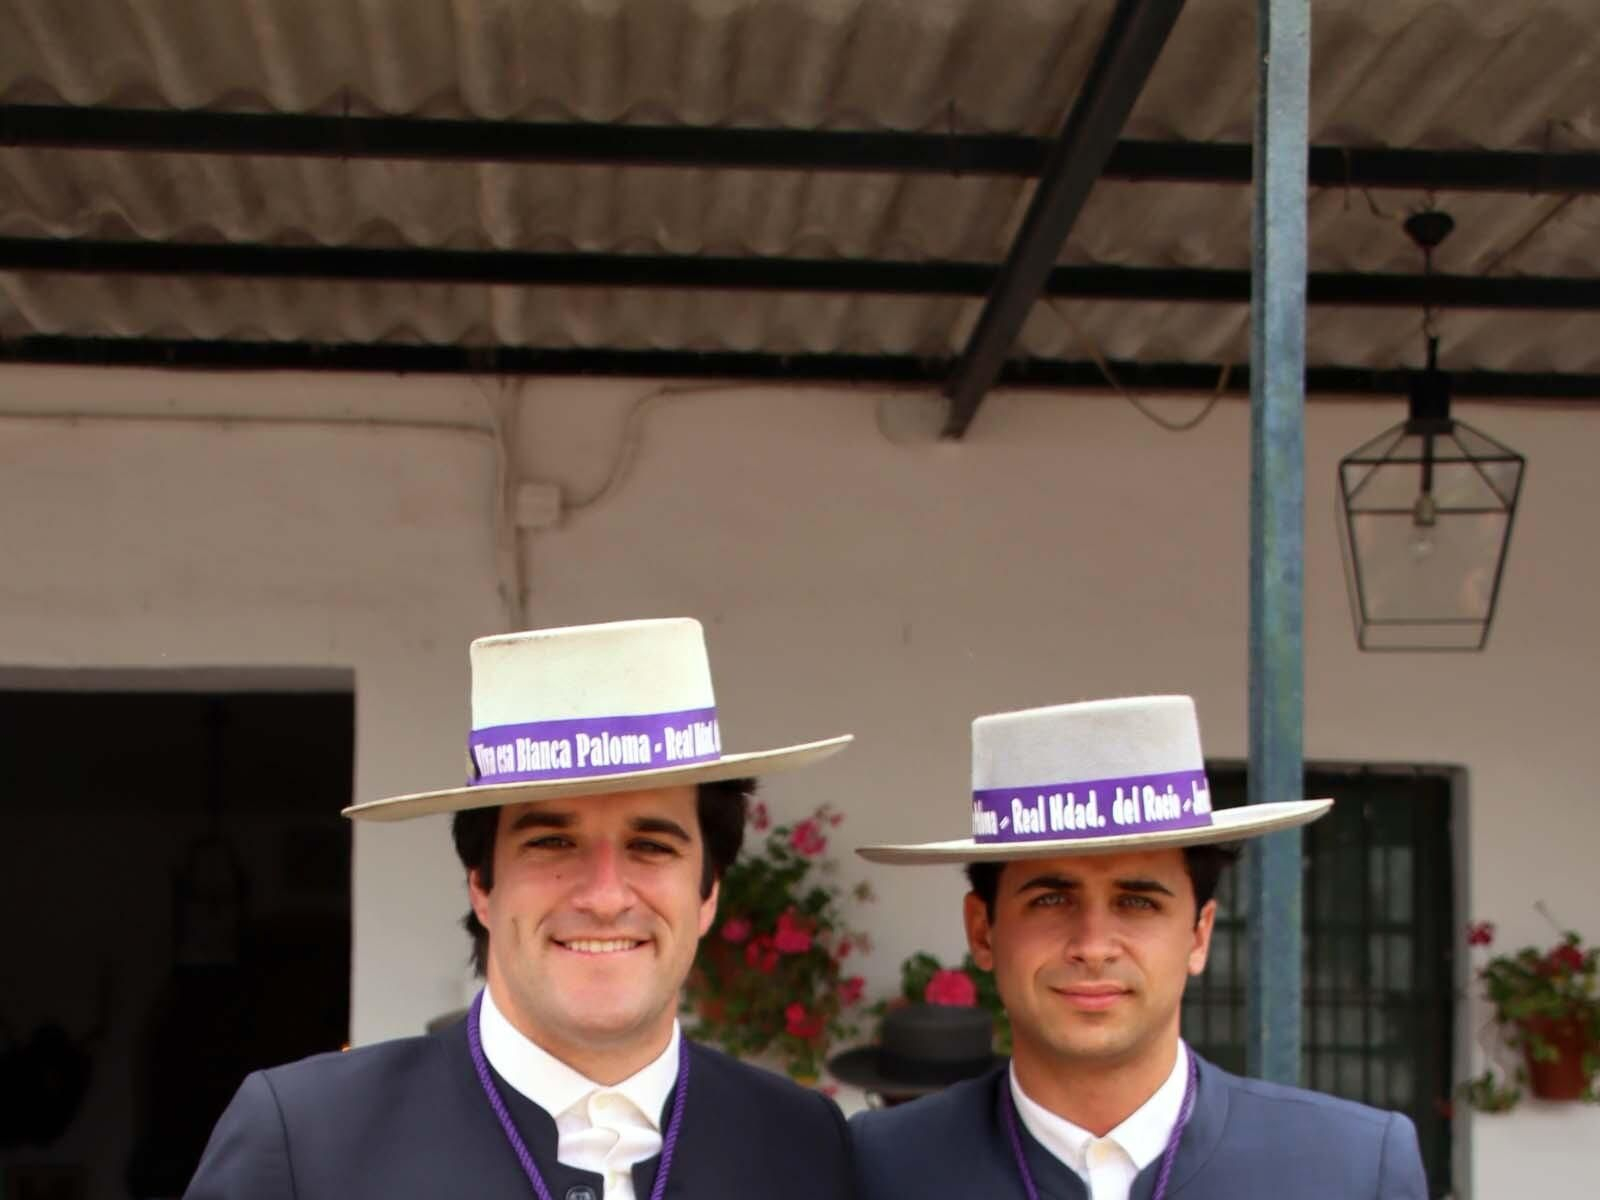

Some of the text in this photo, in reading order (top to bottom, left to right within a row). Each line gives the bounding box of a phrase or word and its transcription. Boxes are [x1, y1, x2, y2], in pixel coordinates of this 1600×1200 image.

[515, 737, 572, 773] Blanca
[575, 731, 651, 768] Paloma
[663, 726, 694, 761] Real
[1011, 794, 1046, 834] Real
[1049, 790, 1107, 832] Hdad.
[1112, 785, 1140, 825] del
